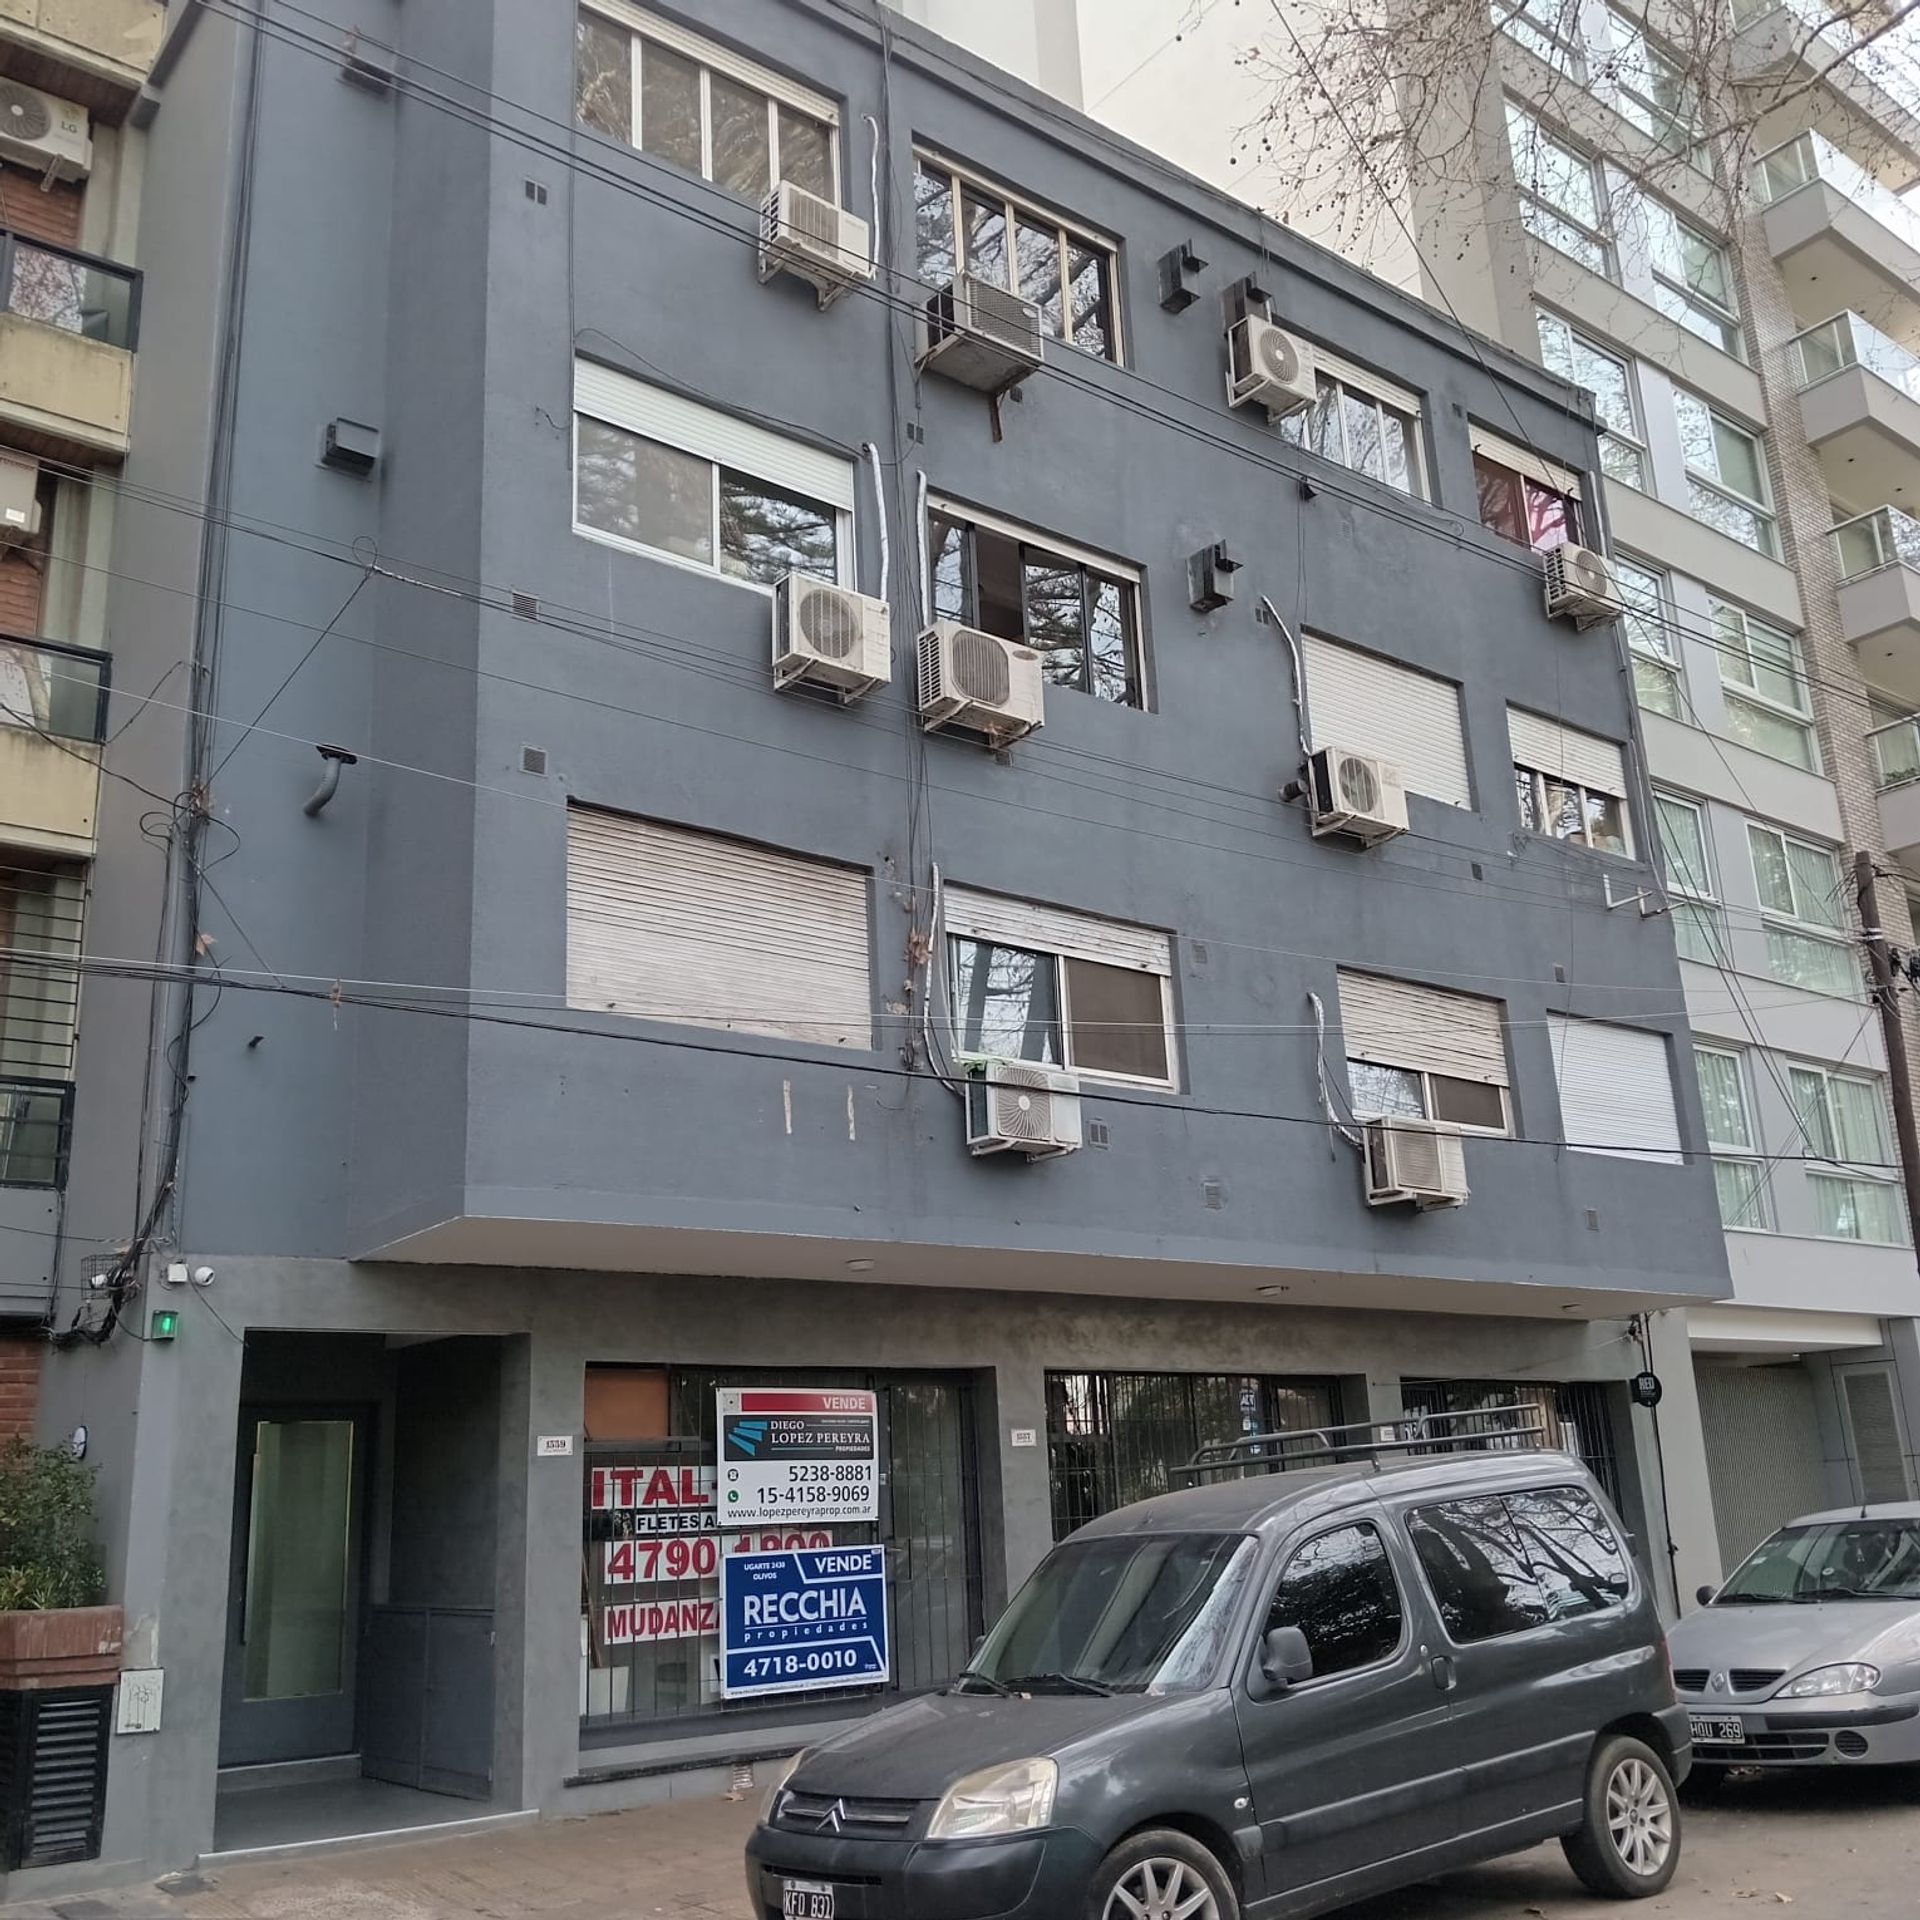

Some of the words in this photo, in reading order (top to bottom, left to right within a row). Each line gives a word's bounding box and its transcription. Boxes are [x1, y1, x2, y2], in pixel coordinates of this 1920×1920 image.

[61, 121, 78, 134] LG
[822, 1396, 866, 1410] VENDE
[770, 1420, 805, 1430] DIEGO
[771, 1432, 814, 1444] LOPEZ
[816, 1432, 870, 1444] PEREYRA
[788, 1465, 871, 1482] 5238-8881
[757, 1485, 870, 1504] 15-4158-9069
[727, 1505, 871, 1519] www.lopezpereyraprop.com.ar
[637, 1515, 699, 1531] FLETES
[607, 1538, 716, 1580] 4790
[814, 1554, 872, 1574] VENDE
[752, 1572, 777, 1581] OLIVOS
[743, 1586, 867, 1626] RECCHIA
[607, 1602, 720, 1638] MUDANZ
[744, 1622, 868, 1643] propiedades
[743, 1649, 857, 1677] 4718-0010
[1719, 1723, 1741, 1738] 269
[785, 1891, 806, 1916] KFO
[810, 1894, 831, 1919] 831
